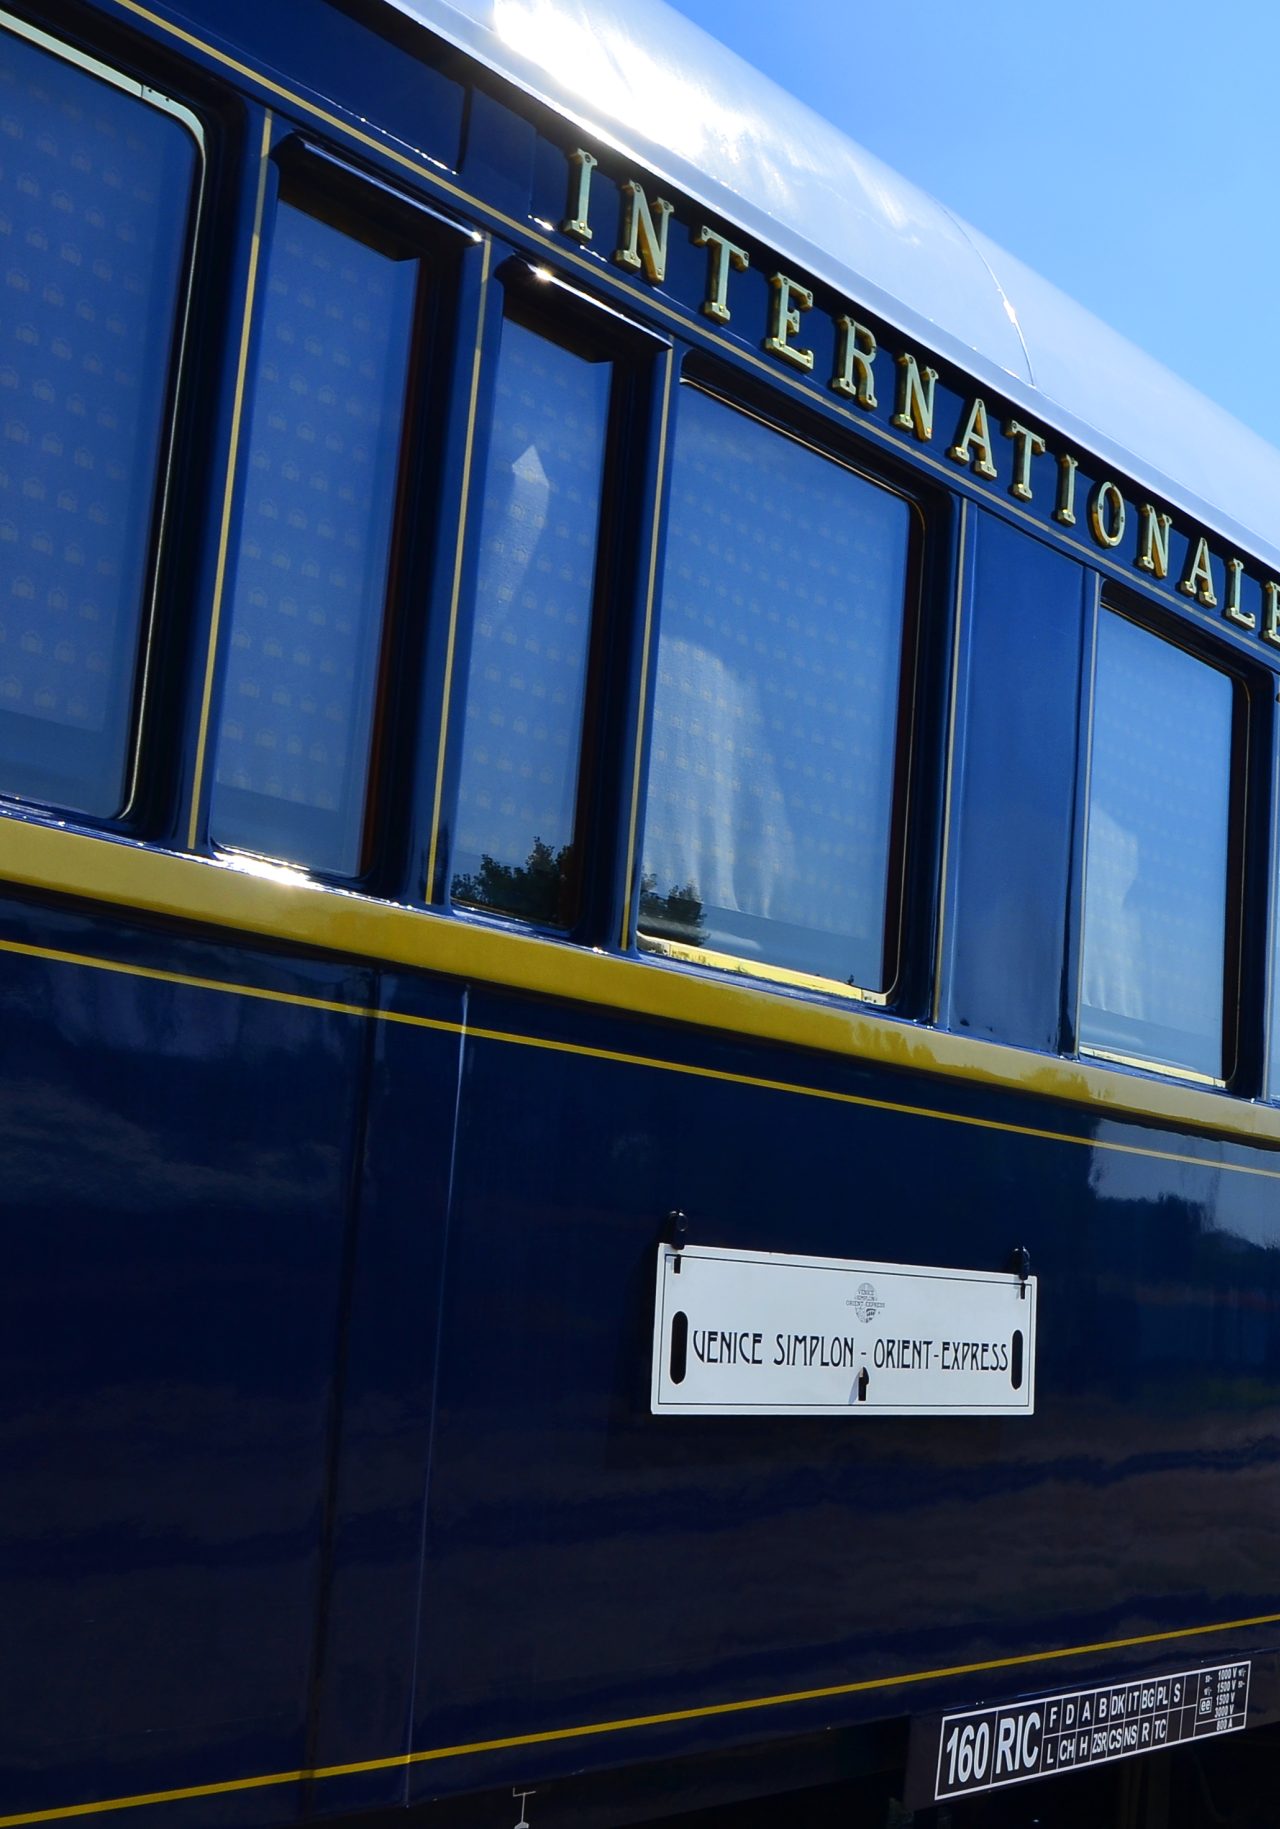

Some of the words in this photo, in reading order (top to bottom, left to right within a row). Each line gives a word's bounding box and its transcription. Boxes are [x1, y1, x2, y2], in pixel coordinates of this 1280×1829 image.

[693, 1330, 763, 1365] VENICE
[773, 1333, 854, 1367] SIMPLON
[873, 1337, 1009, 1372] ORIENT-EXPRESS
[1049, 1706, 1058, 1728] F
[1065, 1704, 1075, 1725] D
[1081, 1701, 1091, 1722] A
[1099, 1697, 1107, 1718] B
[1111, 1694, 1126, 1716] DK
[1128, 1691, 1139, 1712] IT
[1141, 1688, 1155, 1710] BG
[1156, 1686, 1168, 1706] PL
[1173, 1683, 1181, 1703] S
[946, 1722, 990, 1785] 160
[995, 1711, 1041, 1774] RIC
[1046, 1743, 1054, 1764] L
[1059, 1737, 1075, 1761] CH
[1079, 1735, 1088, 1757] H
[1108, 1728, 1122, 1752] CS
[1123, 1724, 1137, 1747] NS
[1141, 1721, 1149, 1742] R
[1154, 1718, 1166, 1740] TC
